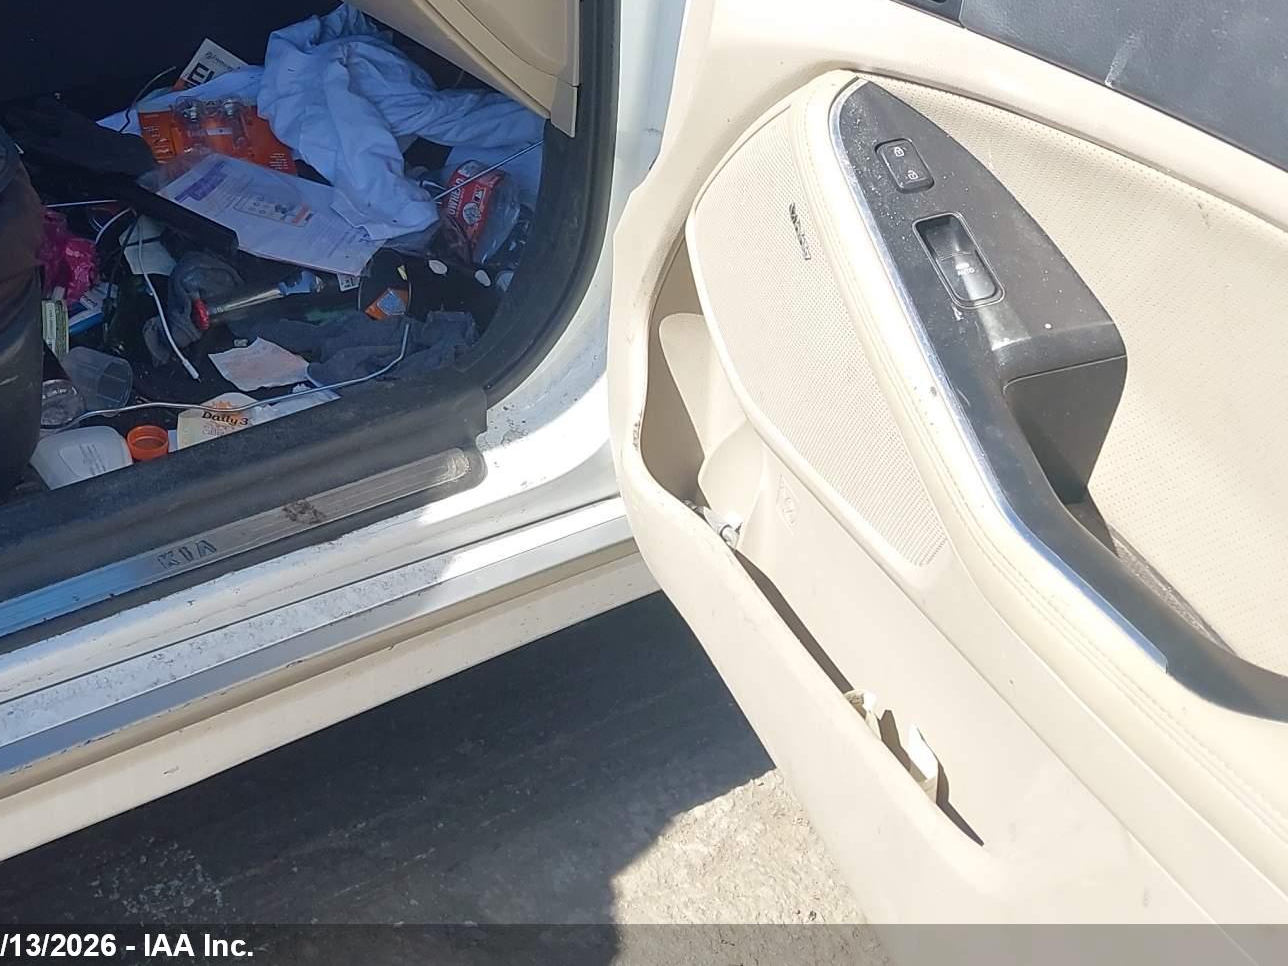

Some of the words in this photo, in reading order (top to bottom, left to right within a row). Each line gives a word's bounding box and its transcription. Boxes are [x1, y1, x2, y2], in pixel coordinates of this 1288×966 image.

[957, 267, 975, 276] AUTO
[201, 410, 238, 426] Daily
[239, 417, 249, 426] 3
[157, 539, 217, 569] KIA
